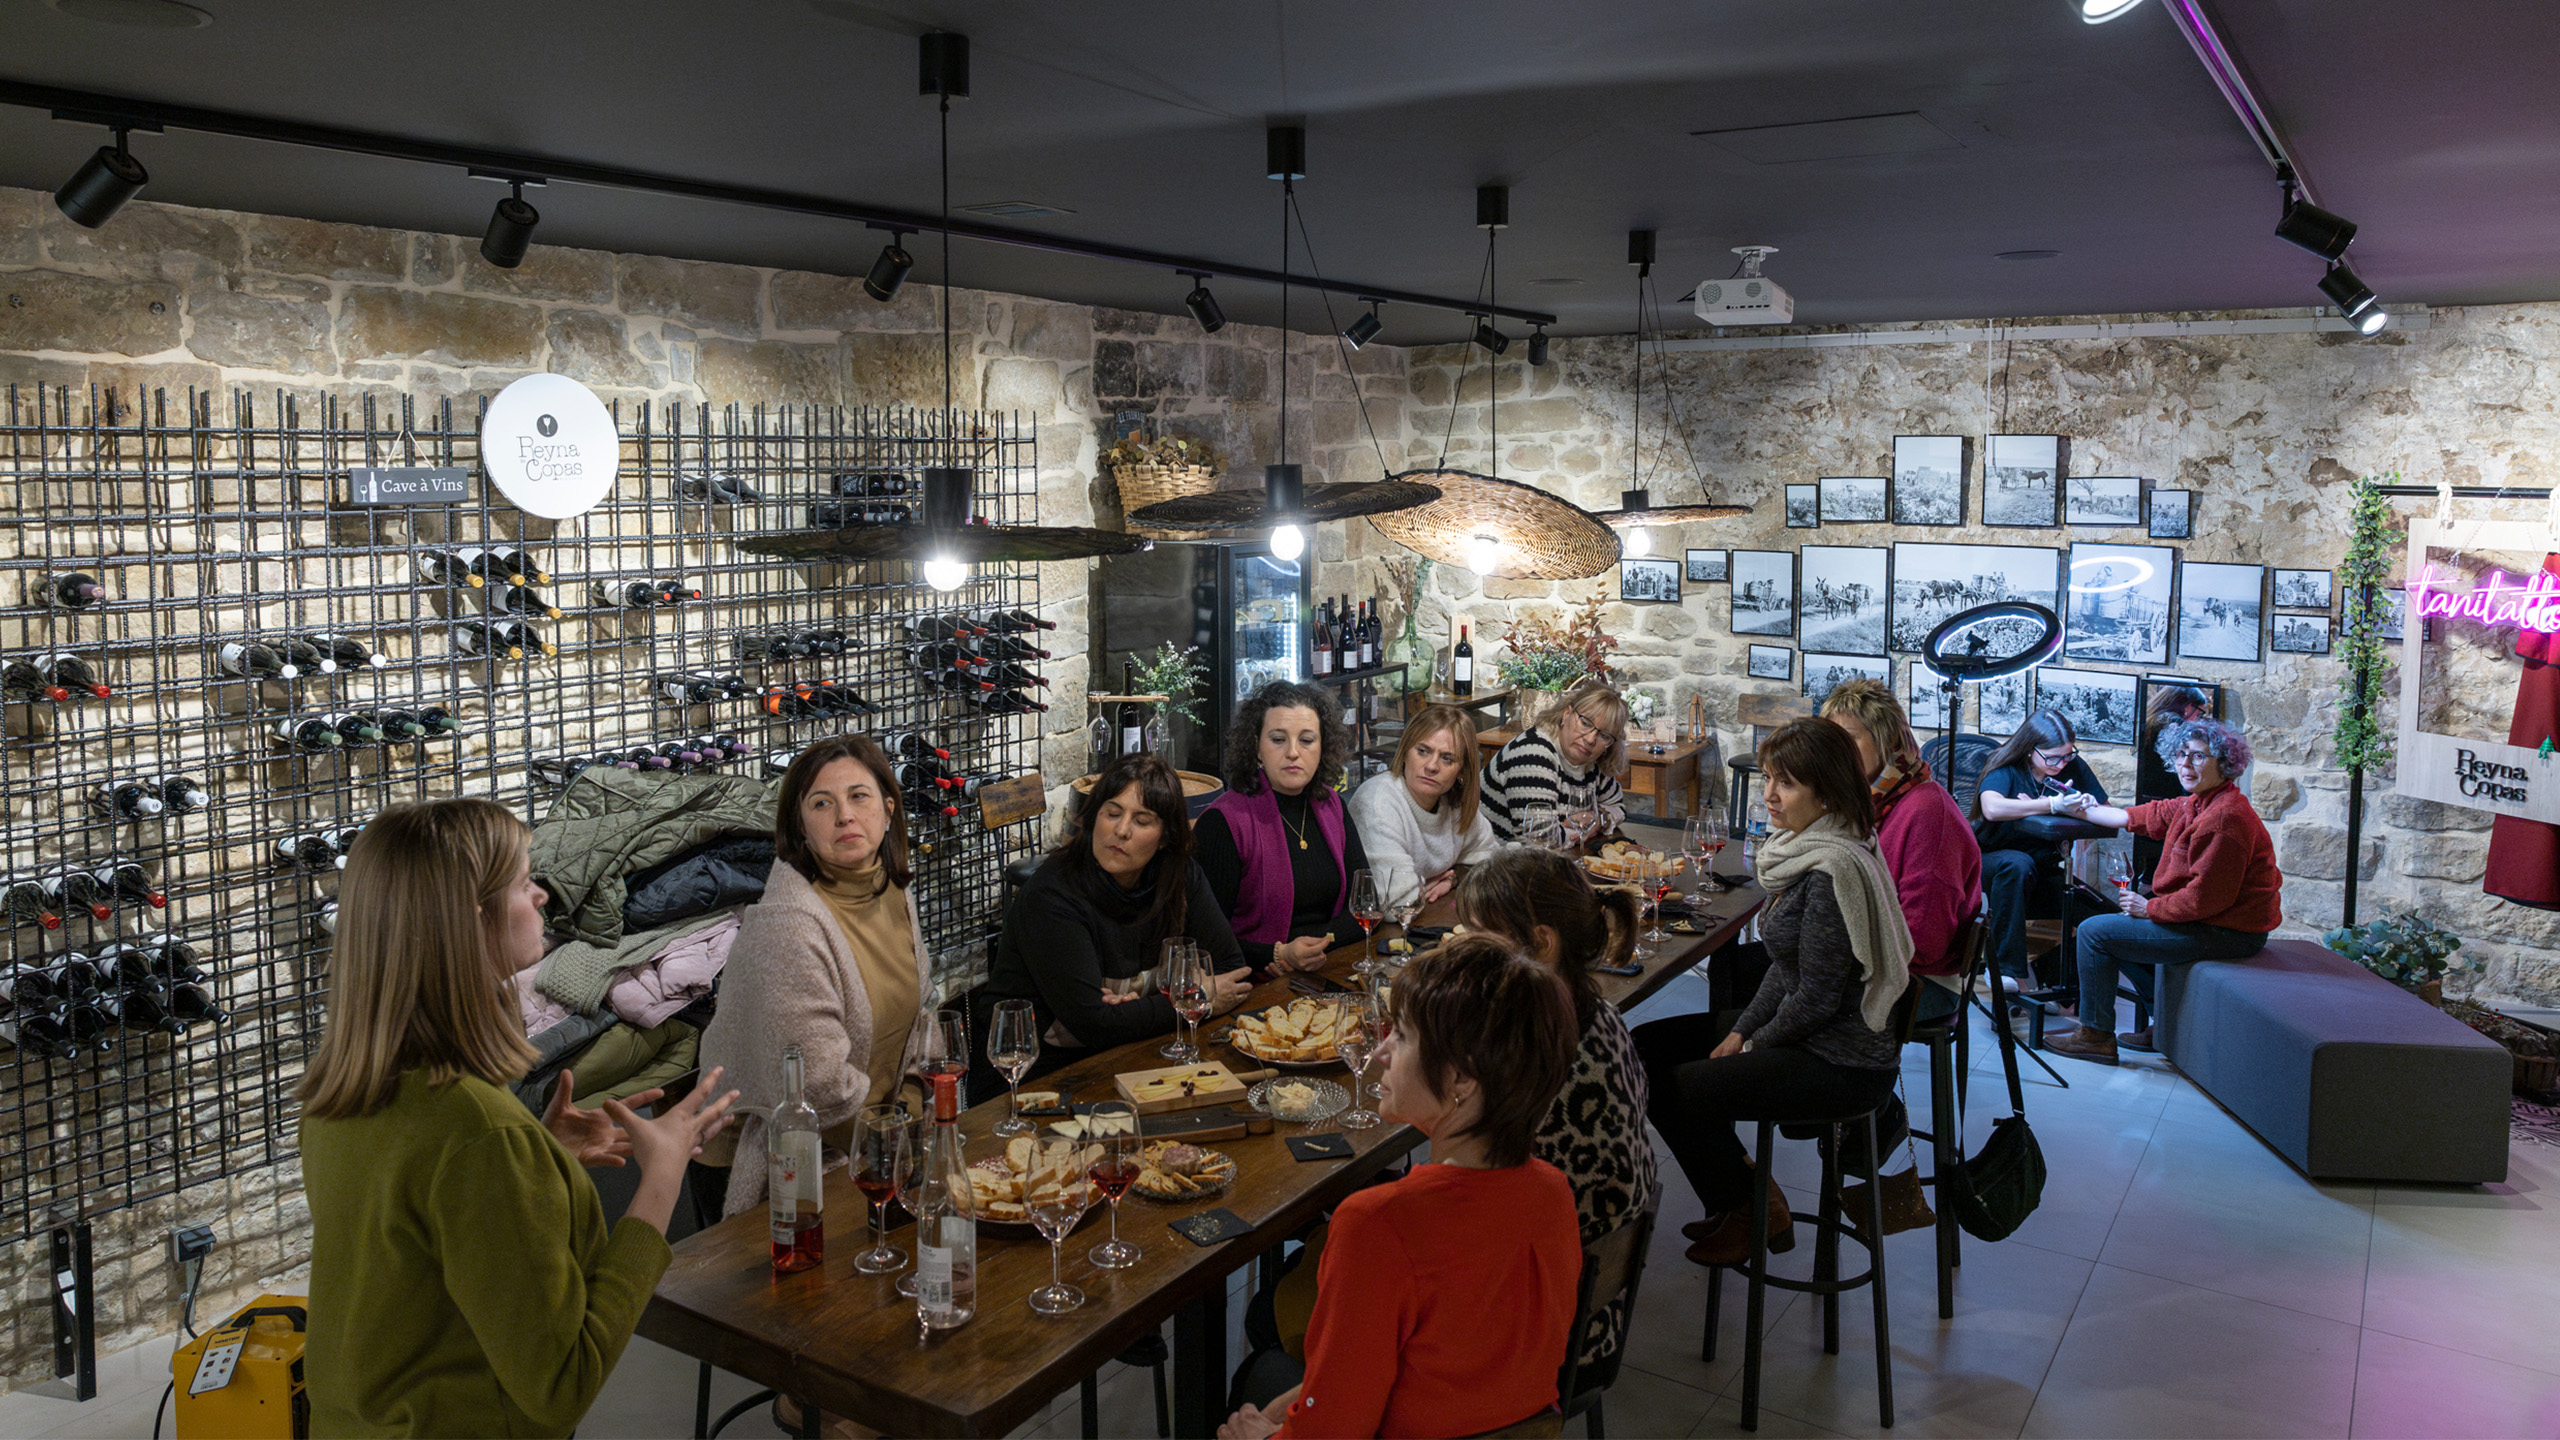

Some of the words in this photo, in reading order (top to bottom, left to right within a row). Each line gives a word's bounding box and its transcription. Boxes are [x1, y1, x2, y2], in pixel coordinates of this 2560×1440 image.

[516, 435, 581, 462] Reyna
[525, 459, 583, 482] Copas
[381, 479, 417, 493] Cave
[420, 477, 429, 492] à
[430, 477, 464, 492] Vins
[2455, 747, 2529, 781] Reyna
[2459, 773, 2528, 802] Copas
